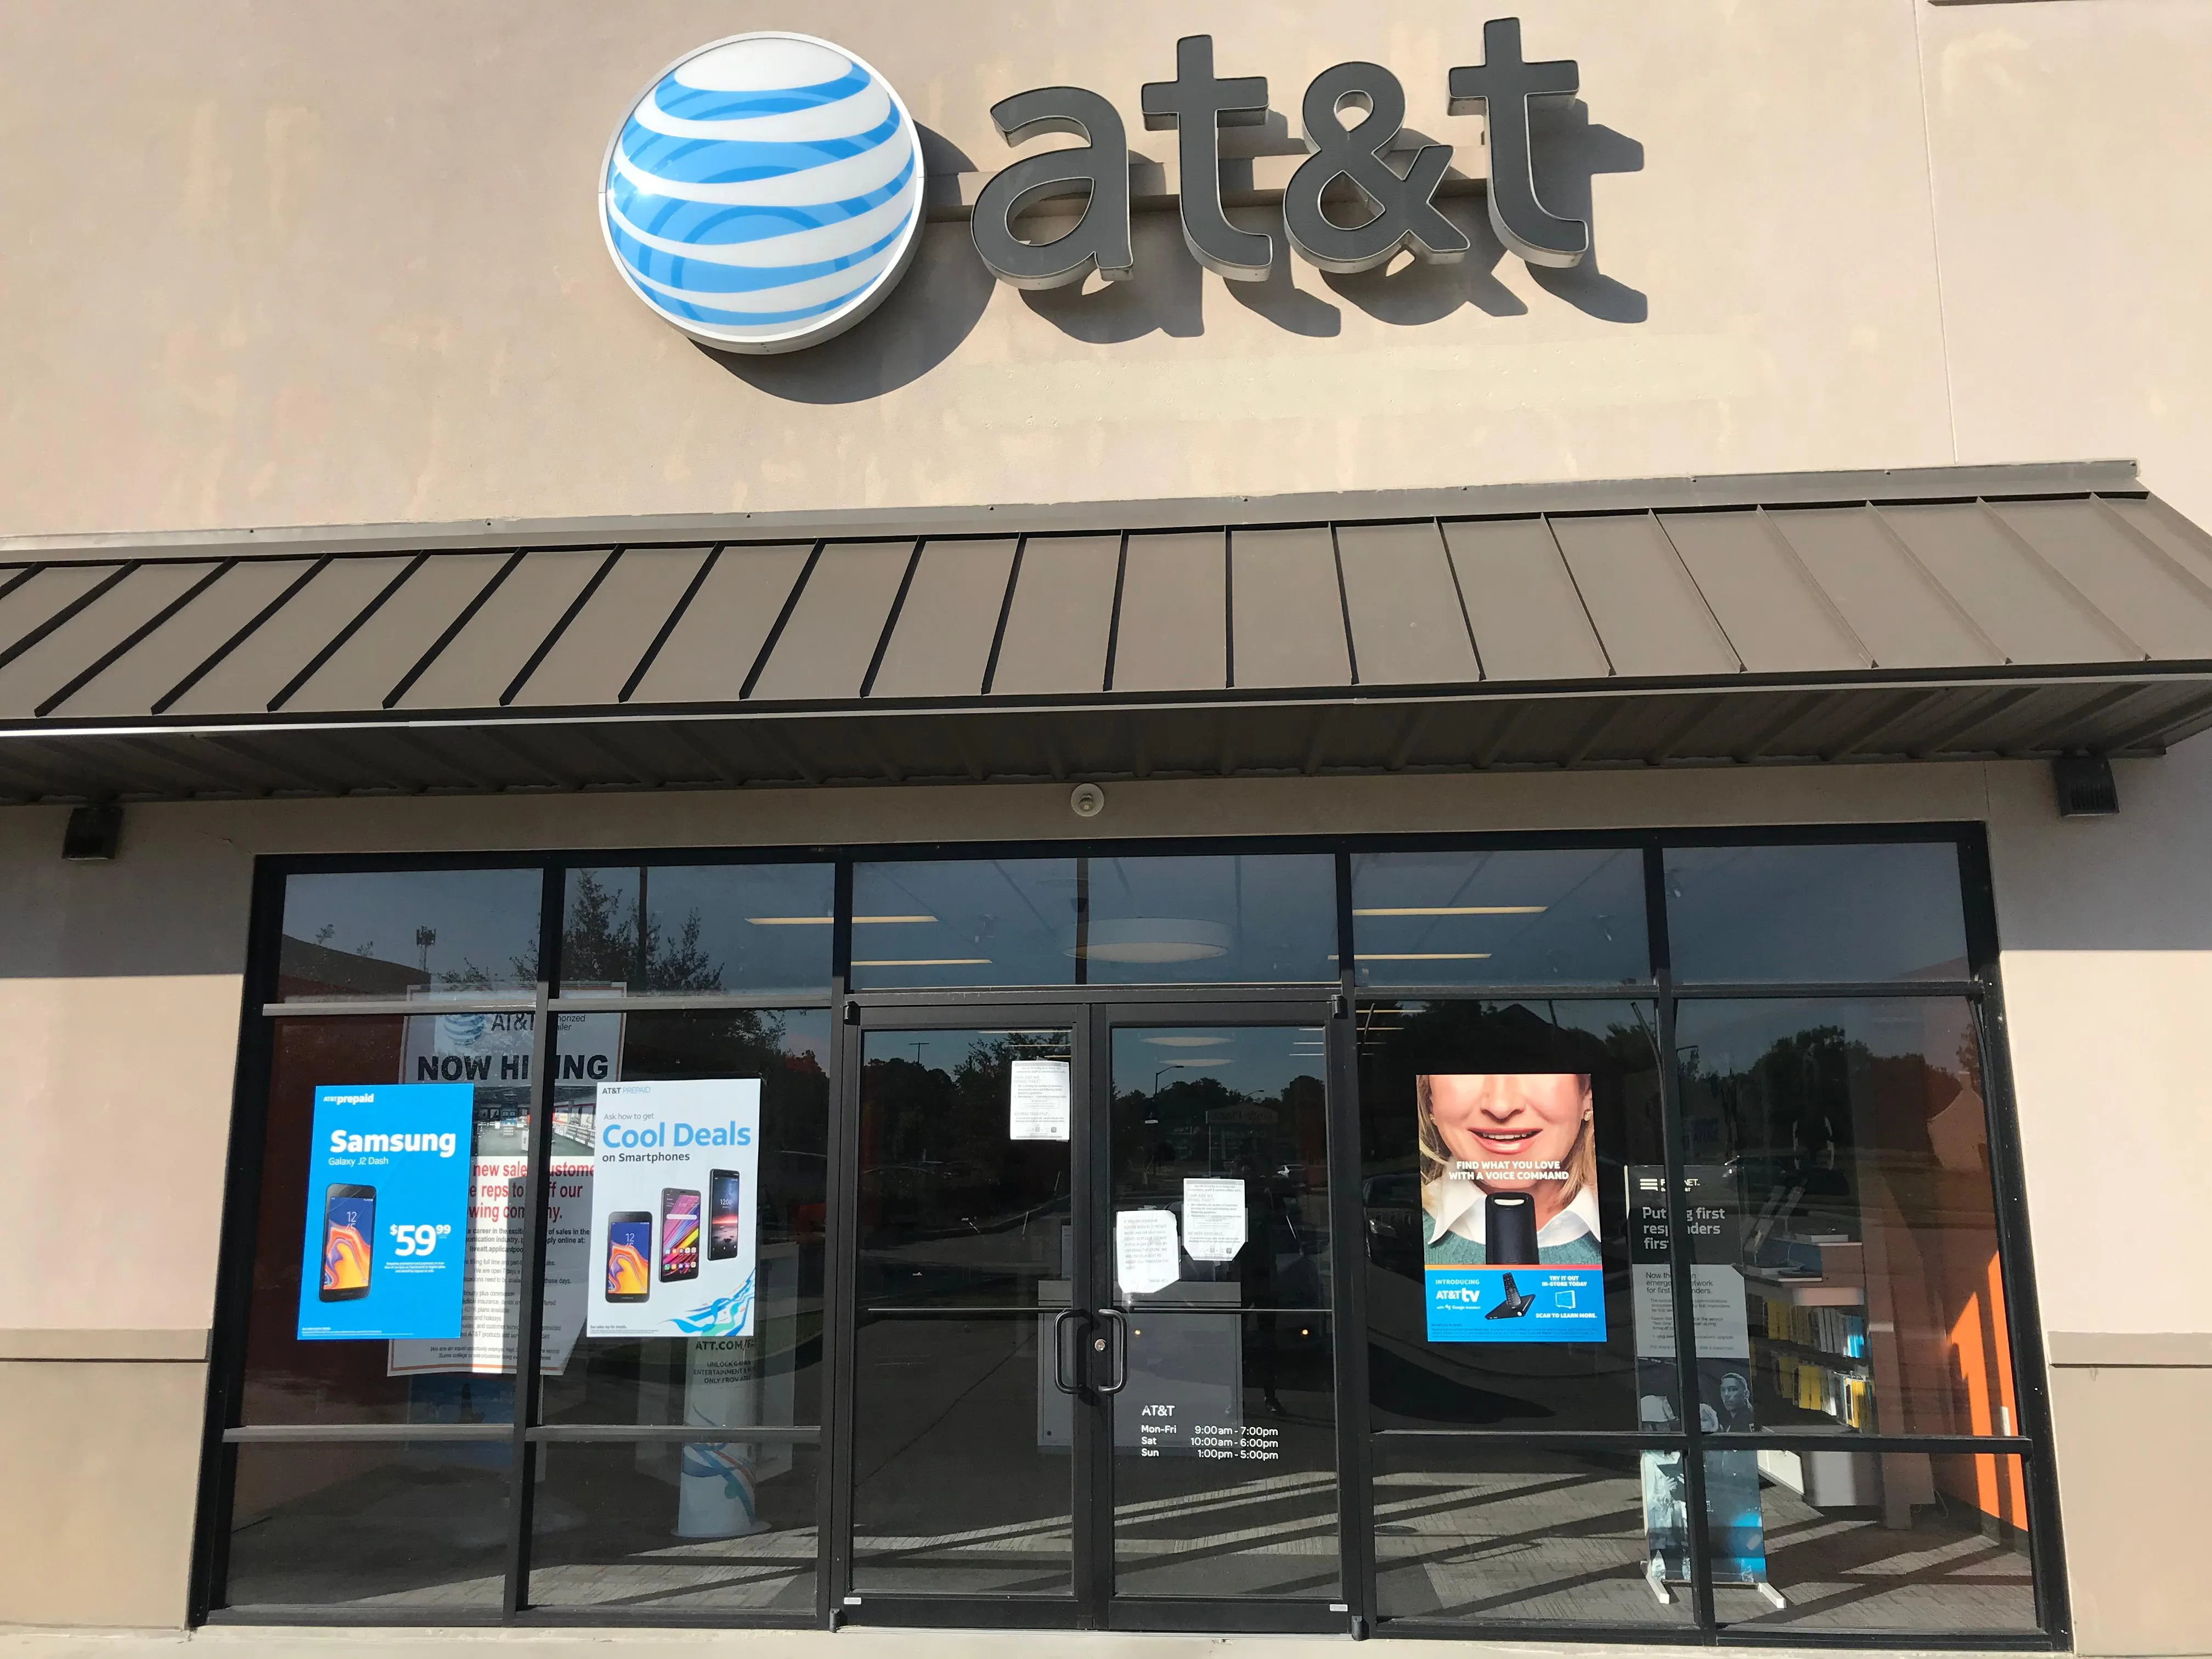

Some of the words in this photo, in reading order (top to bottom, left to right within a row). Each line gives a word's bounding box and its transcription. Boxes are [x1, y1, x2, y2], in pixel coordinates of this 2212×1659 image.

[418, 1055, 491, 1081] NOW
[501, 1054, 608, 1080] HIING
[603, 1122, 665, 1148] Cool
[674, 1121, 751, 1147] Deals
[330, 1130, 456, 1158] Samsung
[329, 1157, 356, 1167] Galaxy
[358, 1157, 366, 1165] J2
[368, 1156, 388, 1165] Dash
[618, 1152, 690, 1164] Smartphones
[473, 1164, 499, 1177] new
[503, 1161, 527, 1177] sale
[550, 1161, 594, 1177] ustome
[1456, 1161, 1479, 1169] FIND
[1481, 1161, 1510, 1169] WHAT
[1512, 1161, 1533, 1169] YOU
[1535, 1161, 1561, 1169] LOVE
[1449, 1172, 1475, 1180] WITH
[1486, 1172, 1515, 1180] VOICE
[1517, 1171, 1569, 1180] COMMAND
[482, 1184, 509, 1201] reps
[512, 1182, 524, 1198] to
[560, 1184, 583, 1198] our
[347, 1211, 357, 1222] 12
[469, 1203, 500, 1222] wing
[503, 1205, 562, 1223] comny.
[1643, 1206, 1693, 1222] Putg
[1696, 1206, 1725, 1219] first
[1643, 1222, 1721, 1237] resders
[625, 1233, 634, 1243] 12
[1644, 1237, 1669, 1249] firs
[558, 1278, 571, 1286] days.
[1436, 1290, 1461, 1299] AT&T
[1462, 1288, 1480, 1302] tv
[1142, 1405, 1175, 1417] AT&T
[1141, 1425, 1176, 1434] Mon-Fri
[1195, 1426, 1233, 1435] 9:00am
[1240, 1427, 1278, 1437] 7:00pm
[1142, 1437, 1157, 1445] Sat
[1191, 1437, 1233, 1446] 10:00am
[1240, 1438, 1278, 1449] 6:00pm
[1141, 1448, 1159, 1457] Sun
[1198, 1449, 1233, 1459] 1:00pm
[1240, 1451, 1278, 1461] 5:00pm
